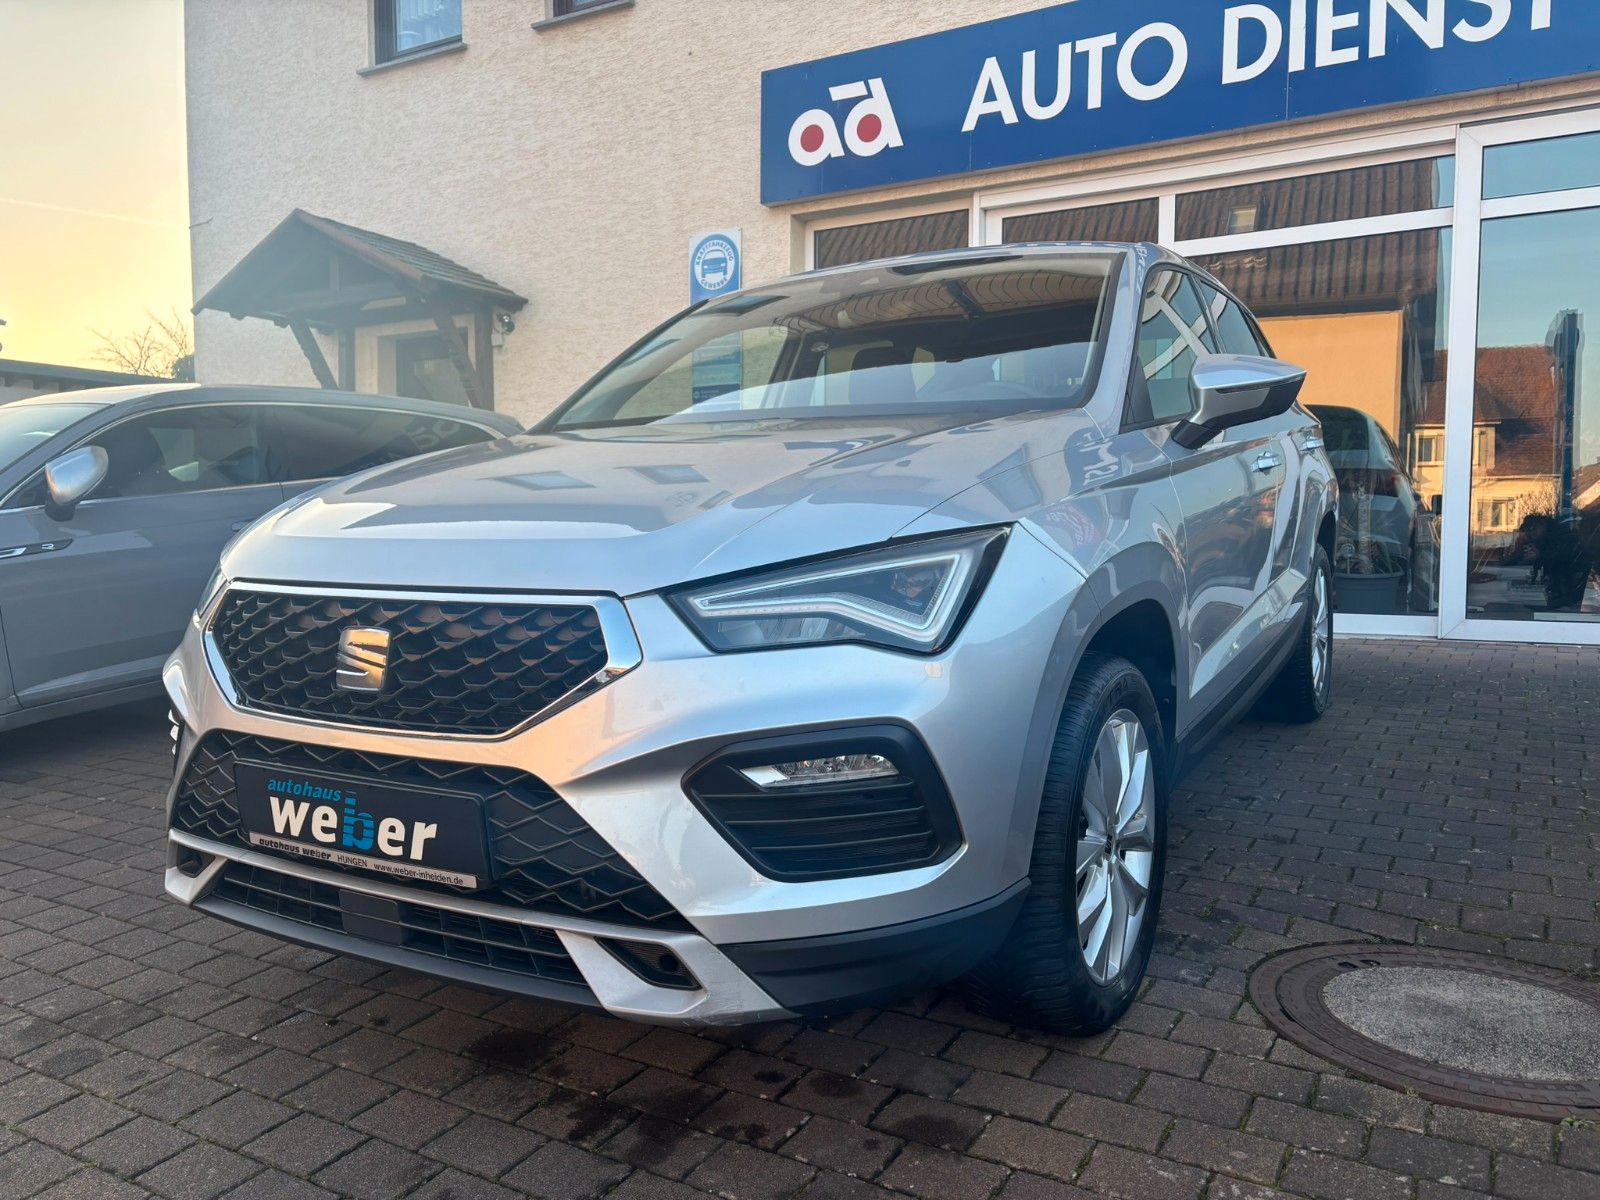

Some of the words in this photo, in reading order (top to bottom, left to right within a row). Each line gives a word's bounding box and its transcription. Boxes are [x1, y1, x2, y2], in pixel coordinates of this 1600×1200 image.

[961, 22, 1188, 133] AUTO
[267, 777, 342, 802] autohaus
[269, 791, 438, 861] weber
[259, 838, 300, 853] autohaus
[302, 847, 332, 860] weber
[337, 854, 368, 867] HUNGEN
[373, 862, 464, 886] www.weber-inheiden.de
